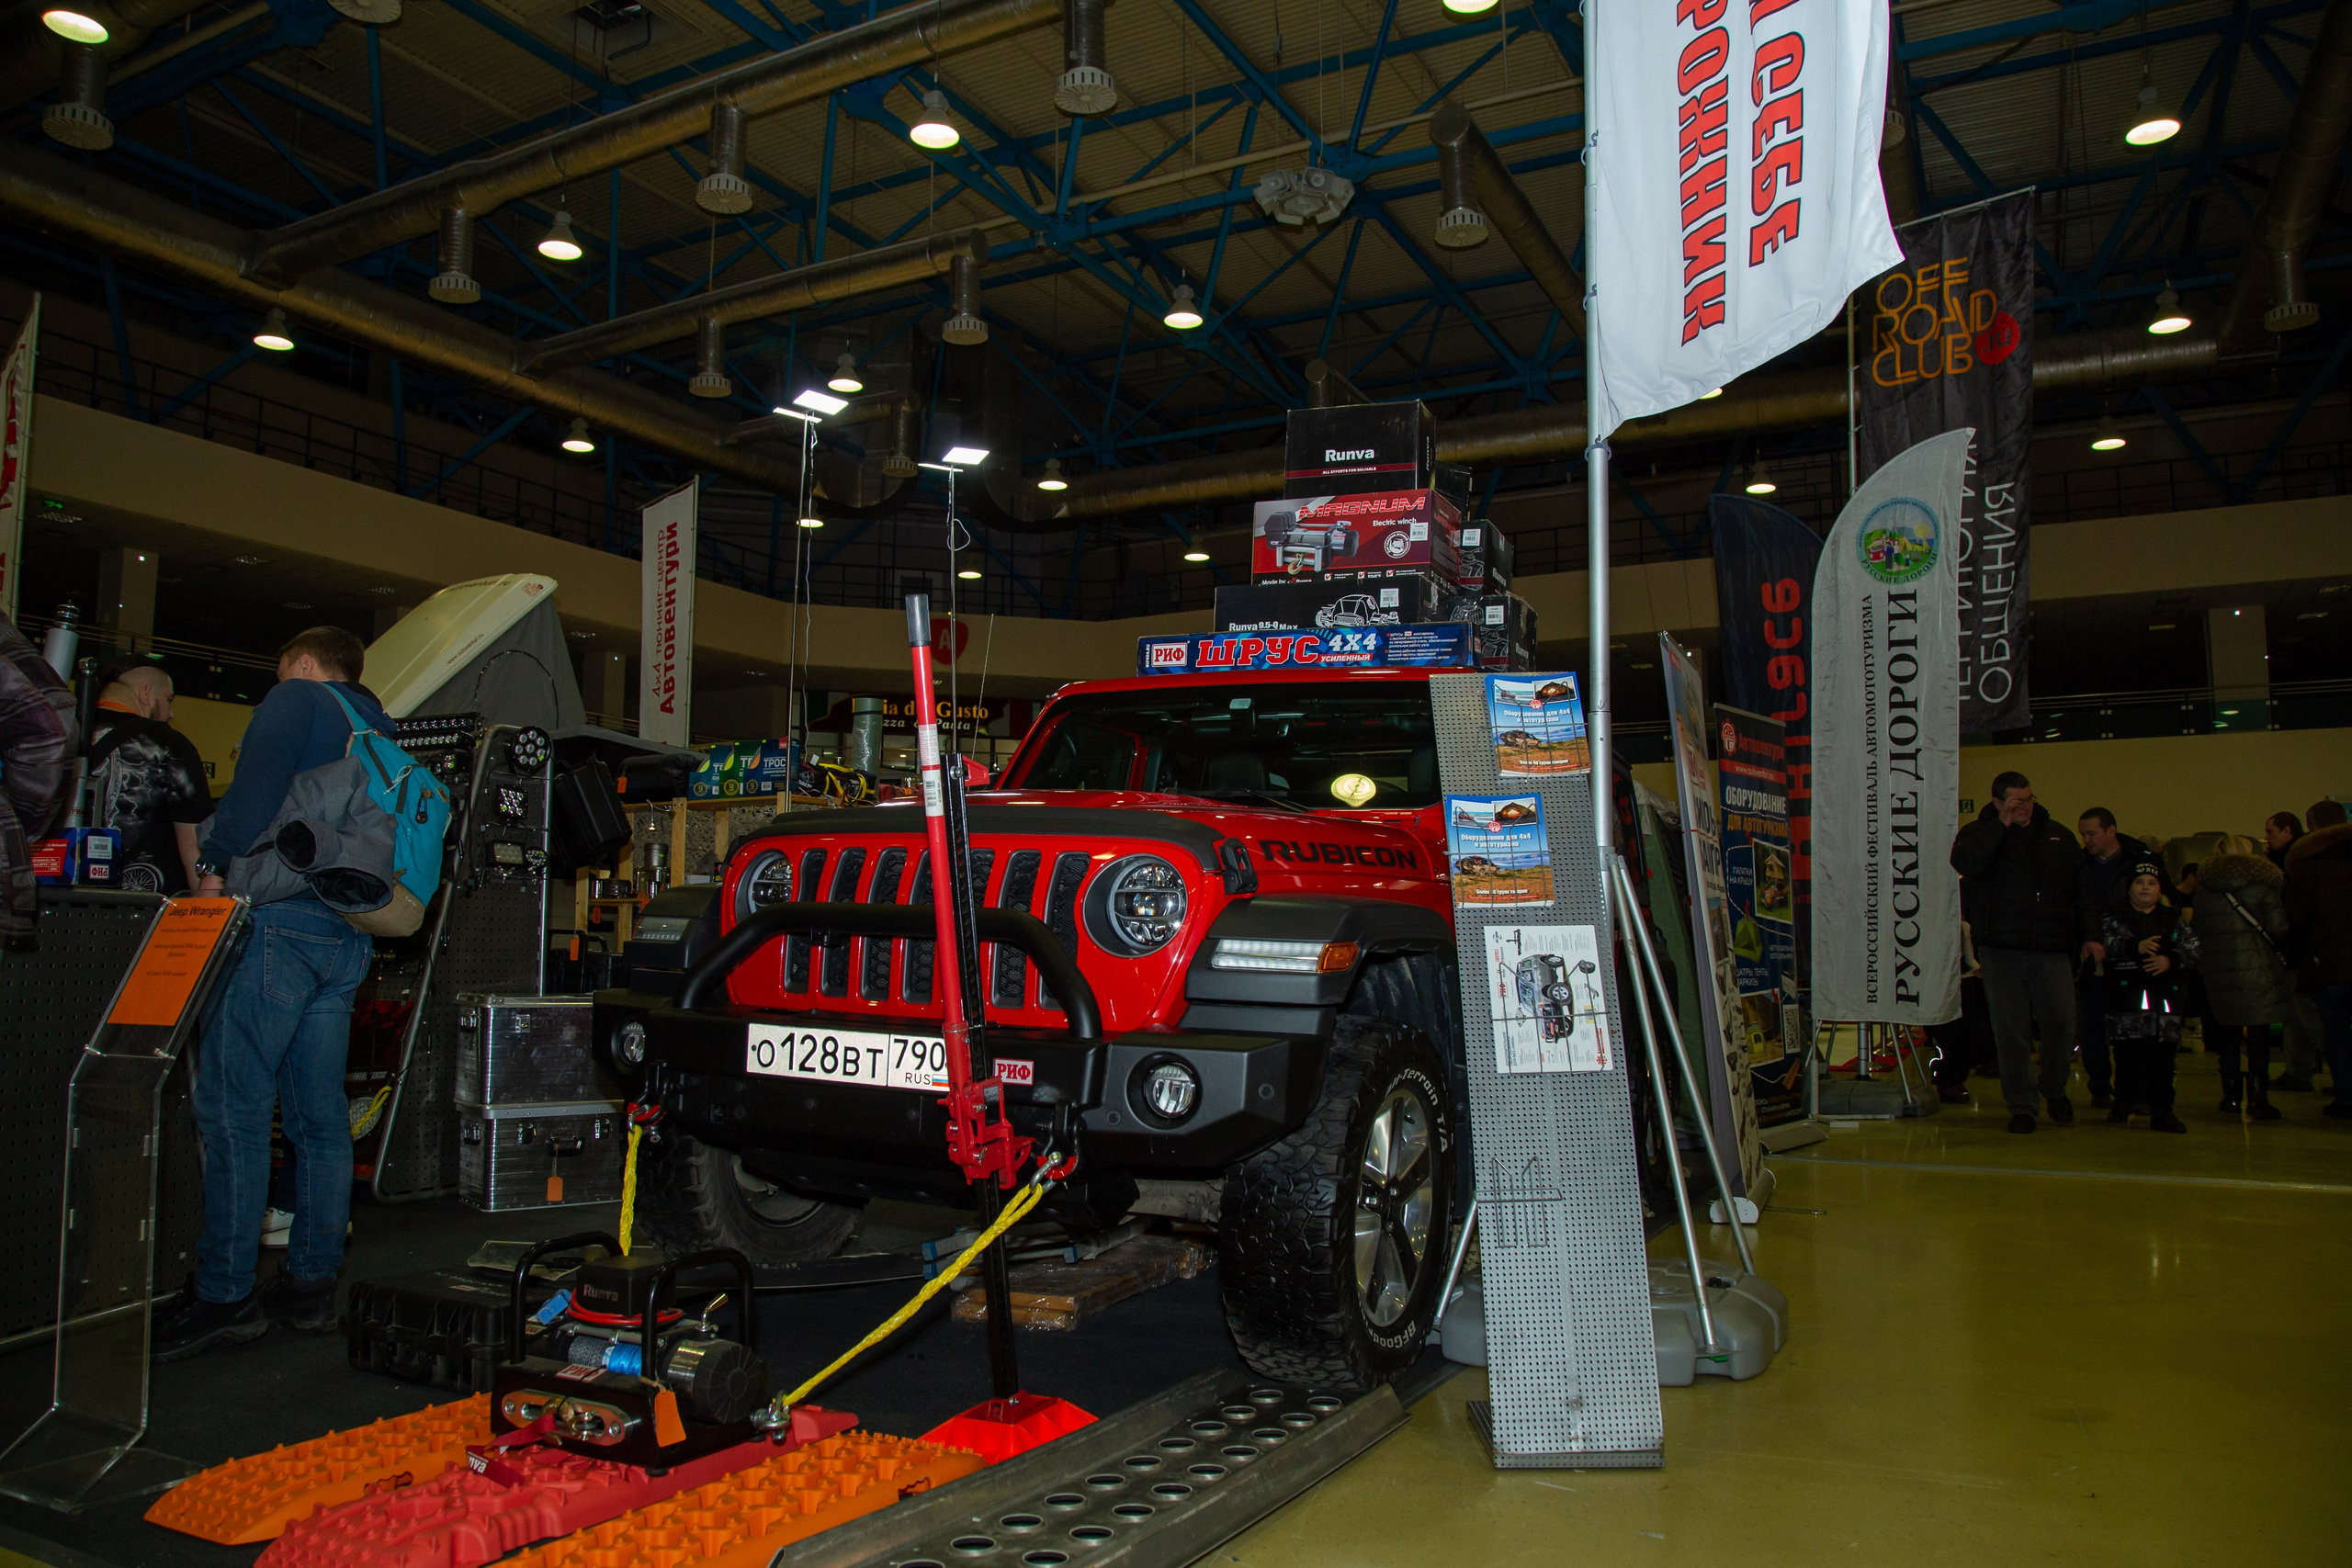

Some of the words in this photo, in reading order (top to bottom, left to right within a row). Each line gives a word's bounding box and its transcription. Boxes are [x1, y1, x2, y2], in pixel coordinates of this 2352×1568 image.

[1749, 31, 1805, 267] СЕБЕ
[1876, 257, 1969, 313] OFF
[1872, 289, 1998, 353] ROAD
[1872, 332, 1973, 387] CLUB
[1325, 448, 1374, 462] Runva
[1298, 497, 1426, 519] MAGNUM
[1373, 518, 1396, 526] Electric
[1861, 558, 1899, 583] РУССКИЕ
[1903, 552, 1938, 583] ДОРОГИ
[1978, 481, 2017, 704] ОБЩЕНИЯ
[1229, 622, 1258, 632] Runva
[1154, 648, 1184, 662] РИФ
[1195, 636, 1320, 668] ШРУС
[1320, 653, 1371, 662] УСИЛЕННЫЙ
[1861, 593, 1878, 758] АВТОМОТОТУРИЗМА
[1888, 589, 1925, 781] ДОРОГИ
[1725, 785, 1787, 815] ОБОРУДОВАНИЕ
[1866, 760, 1879, 859] ФЕСТИВАЛЬ
[1727, 813, 1742, 831] ДЛЯ
[1743, 817, 1789, 838] АВТОТУРИЗМА
[1258, 840, 1418, 870] RUBICON
[1732, 866, 1753, 876] ПАЛАТКИ
[1737, 877, 1753, 886] КРЫШУ
[169, 907, 188, 919] Jeep
[188, 906, 227, 919] Wrangler
[1890, 791, 1921, 1008] РУССКИЕ
[1864, 862, 1879, 1004] ВСЕРОССИЙСКИЙ
[893, 1038, 946, 1073] 790
[905, 1072, 932, 1086] RUS
[997, 1062, 1031, 1081] РИФ
[583, 1283, 619, 1303] Runva
[467, 1454, 487, 1474] nva
